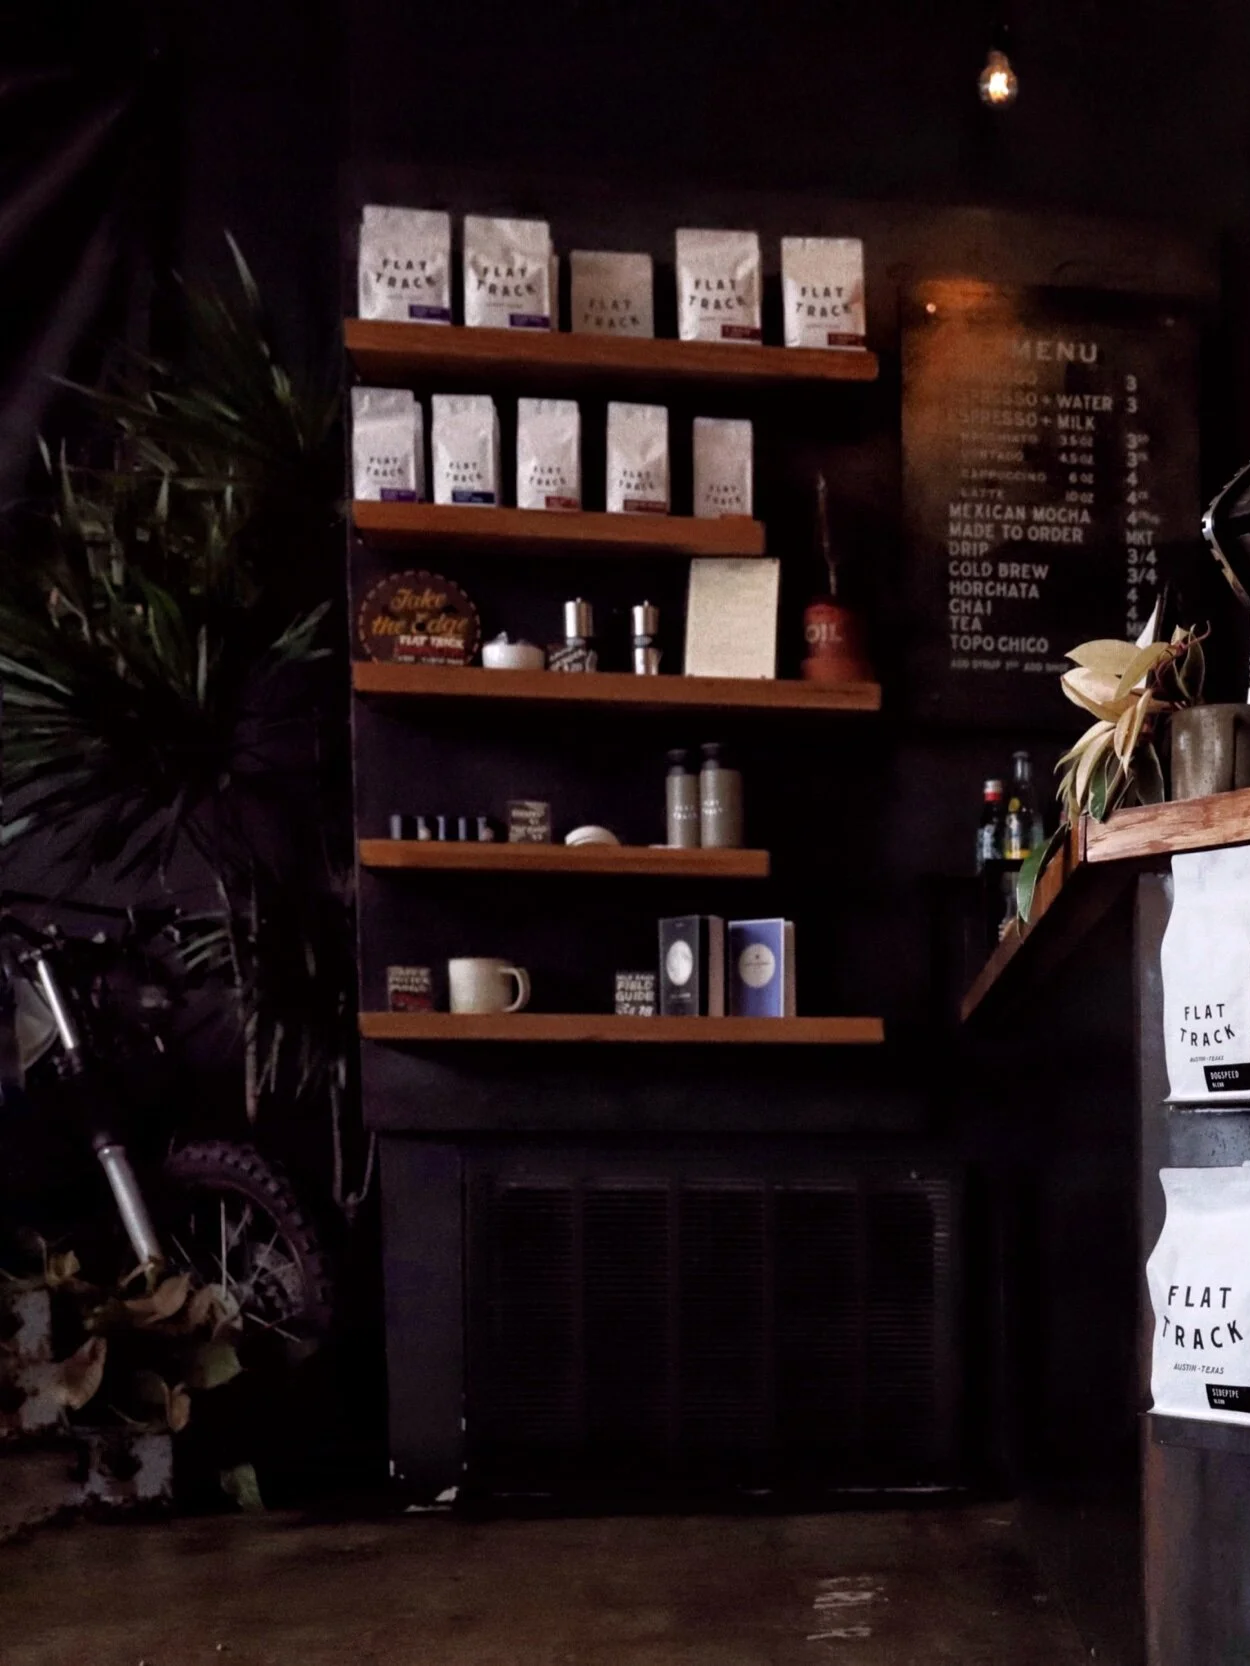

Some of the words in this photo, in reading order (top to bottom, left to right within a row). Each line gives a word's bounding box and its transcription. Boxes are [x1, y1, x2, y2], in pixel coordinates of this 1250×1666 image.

[382, 258, 427, 271] FLAT
[482, 266, 527, 278] FLAT
[376, 271, 437, 290] TRACK
[476, 279, 538, 297] TRACK
[694, 277, 736, 291] FLAT
[800, 285, 843, 299] FLAT
[688, 295, 747, 310] TRACK
[795, 301, 853, 318] TRACK
[1011, 340, 1098, 363] MENU
[1125, 374, 1138, 392] 3
[1056, 394, 1113, 412] WATER
[1126, 396, 1138, 414] 3
[1057, 416, 1096, 431] MILK
[1126, 471, 1138, 487] 4
[960, 487, 1005, 501] LATTE
[948, 502, 1027, 520] MEXICAN
[1032, 505, 1092, 524] MOCHA
[948, 522, 995, 540] MADE
[1001, 525, 1023, 540] TO
[1027, 526, 1084, 544] ORDER
[1125, 530, 1154, 546] MKT
[948, 540, 989, 557] DRIP
[1126, 549, 1158, 565] 3/4
[948, 560, 993, 578] COLD
[998, 562, 1049, 580] BREW
[1126, 568, 1158, 585] 3/4
[948, 580, 1040, 599] HORCHATA
[1126, 587, 1138, 603] 4
[948, 599, 992, 616] CHAI
[1126, 606, 1138, 620] 4
[371, 614, 407, 636] the
[411, 612, 469, 637] Edge
[805, 623, 842, 643] OIL
[949, 616, 983, 632] TEA
[949, 633, 995, 652] TOPO
[998, 635, 1049, 654] CHICO
[617, 980, 653, 991] FIELD
[615, 991, 655, 1002] GUIDE
[1184, 1003, 1225, 1021] FLAT
[1179, 1024, 1236, 1047] TRACK
[1210, 1070, 1240, 1080] DOGSPEED
[1167, 1285, 1232, 1309] FLAT
[1161, 1315, 1244, 1350] TRACK
[1212, 1388, 1240, 1399] SIDEPIPE
